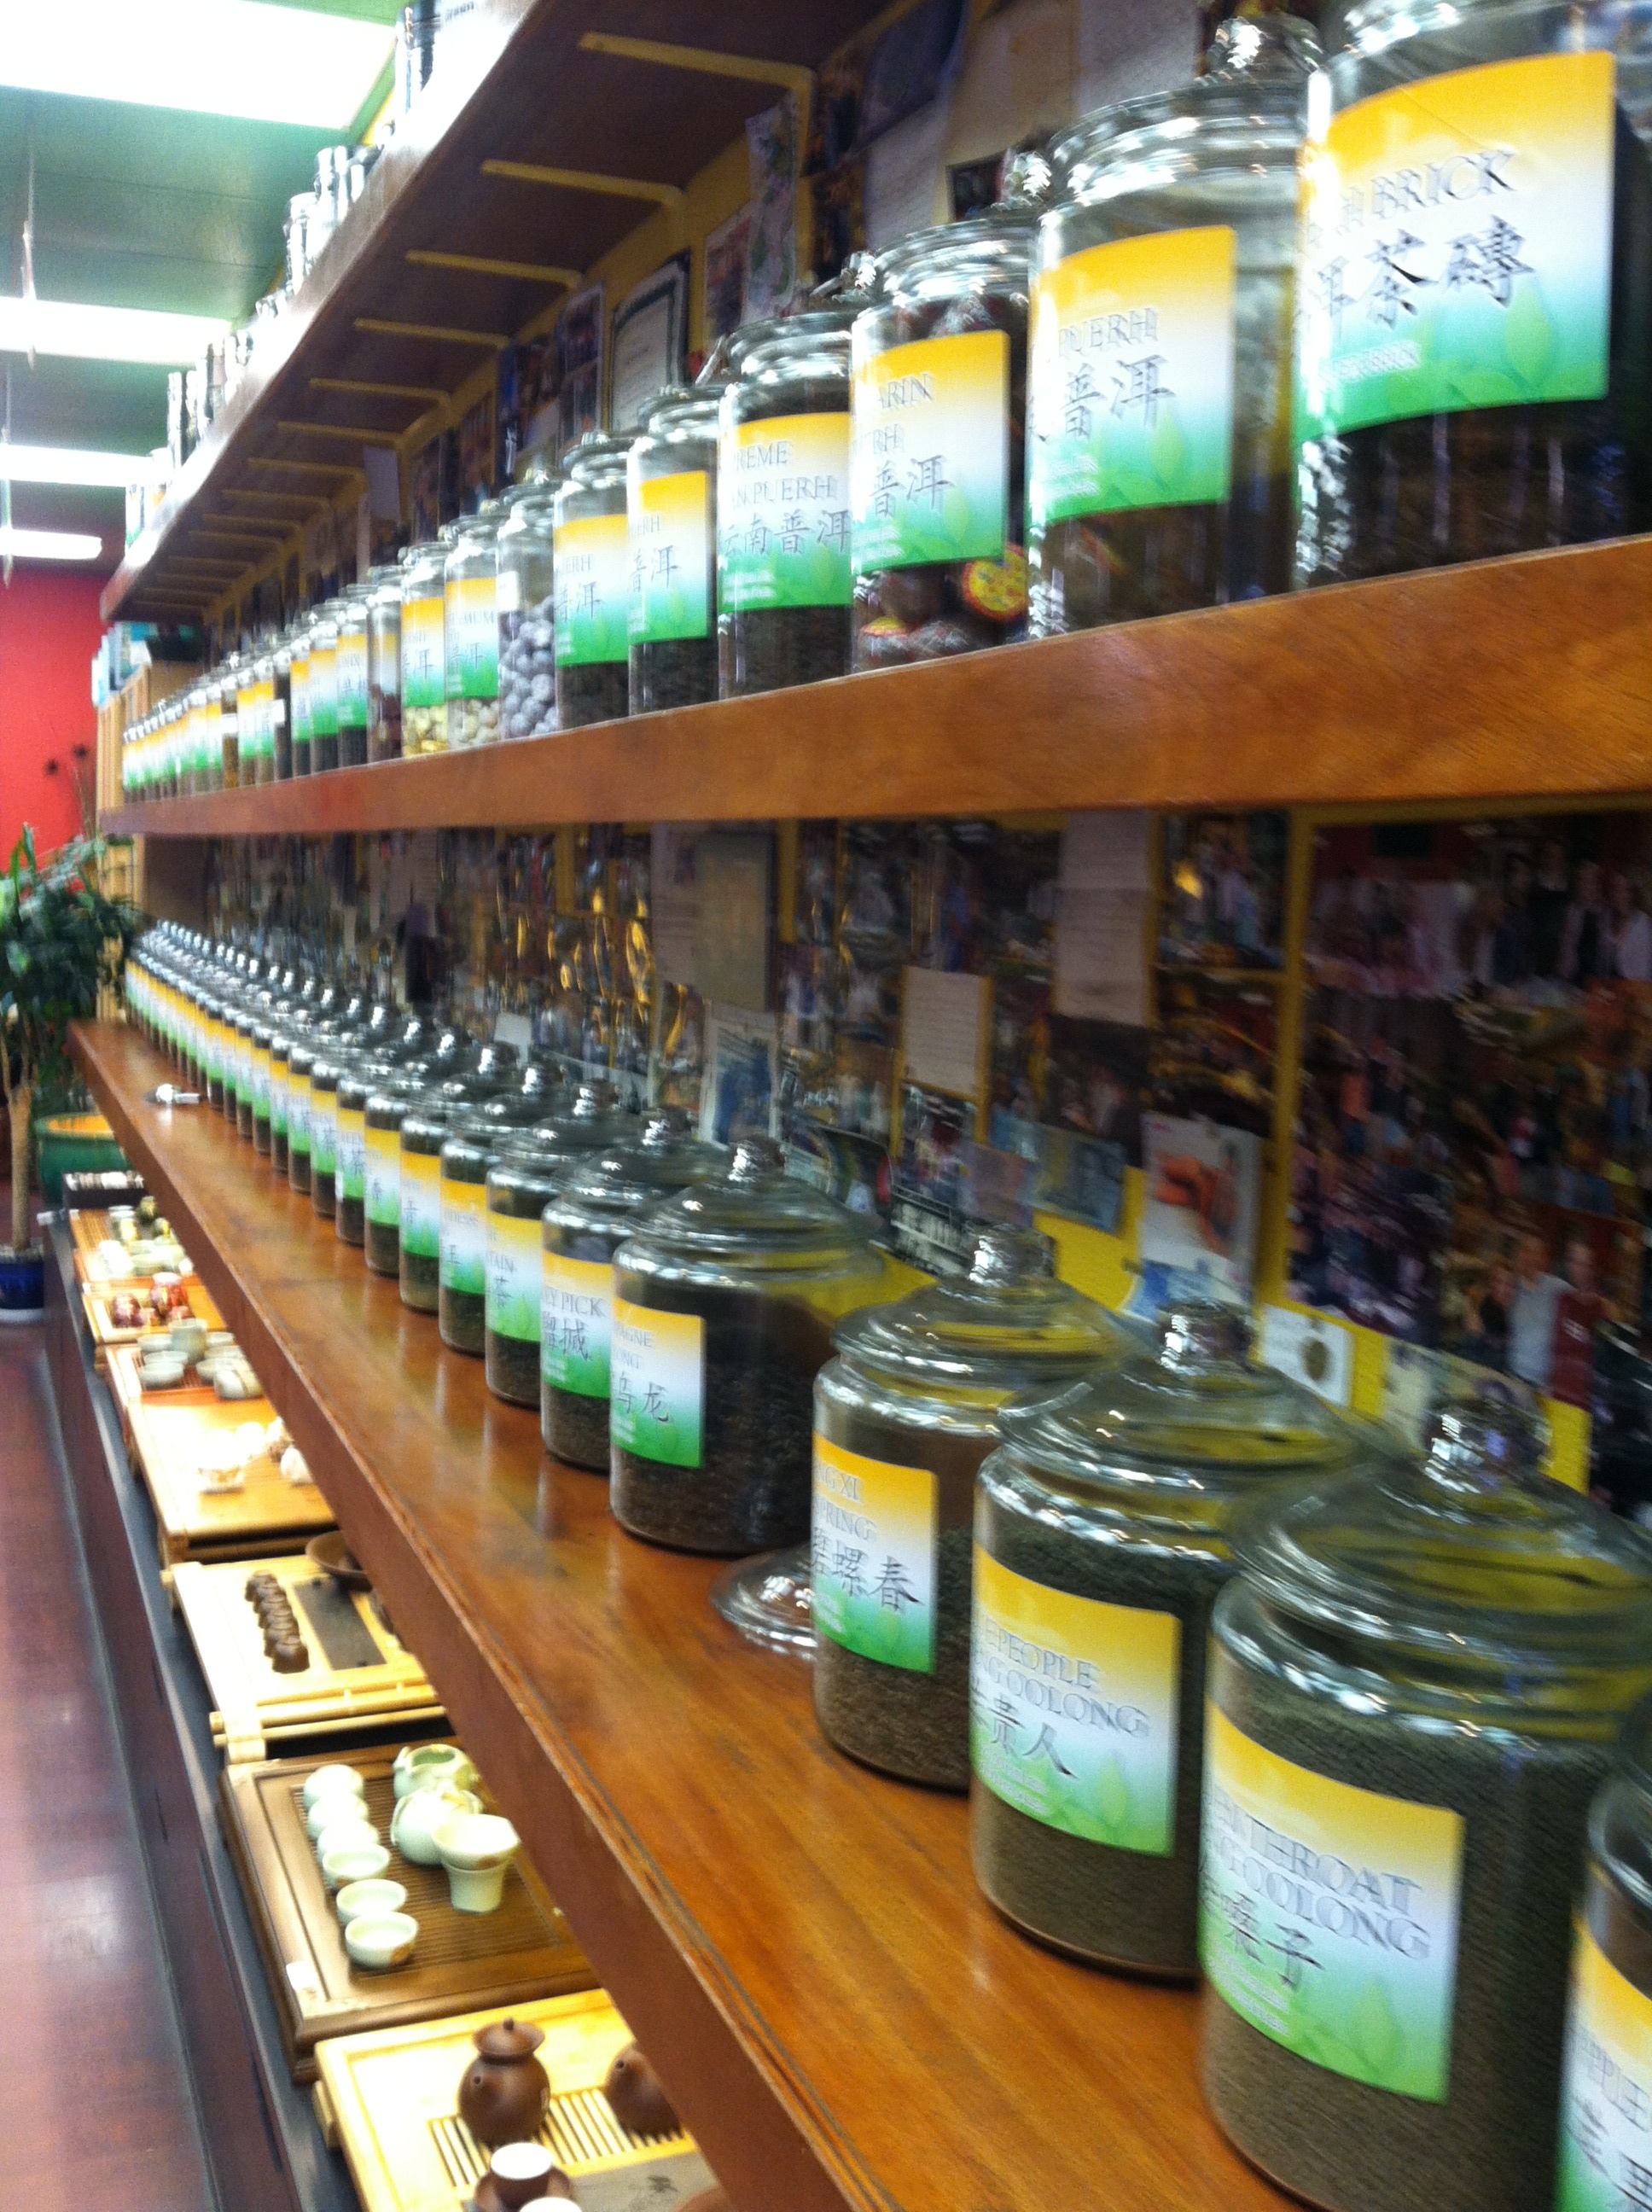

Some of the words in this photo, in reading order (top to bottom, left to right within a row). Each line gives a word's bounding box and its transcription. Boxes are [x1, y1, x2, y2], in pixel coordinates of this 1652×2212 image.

[1371, 148, 1517, 219] BRICK
[561, 1291, 607, 1319] PICK
[998, 1627, 1102, 1690] PEOPLE
